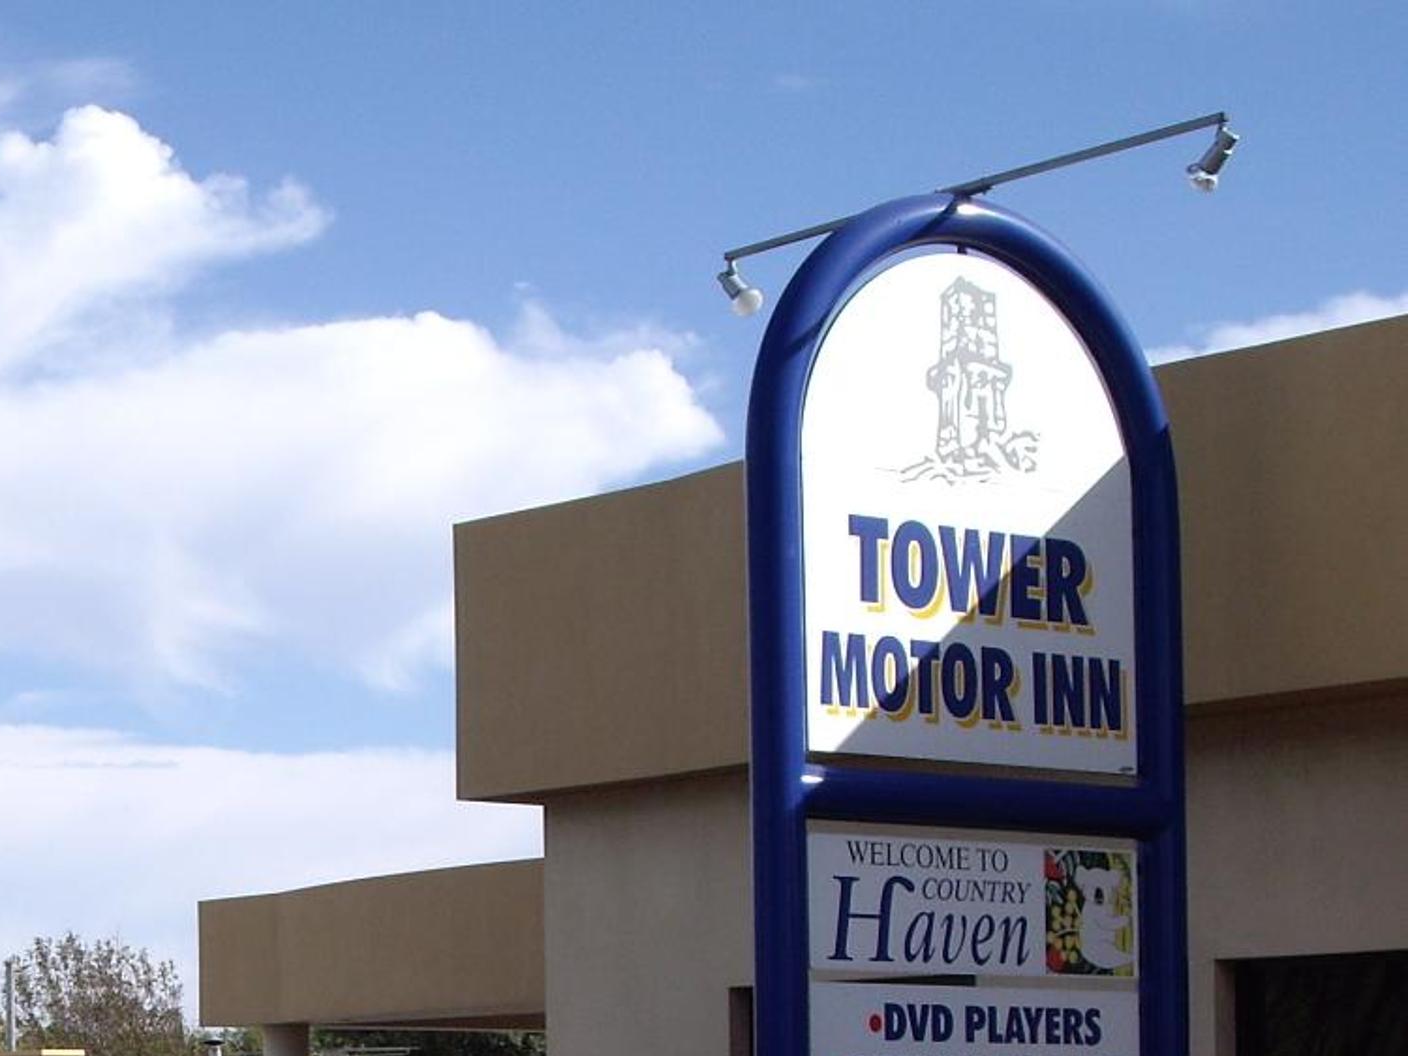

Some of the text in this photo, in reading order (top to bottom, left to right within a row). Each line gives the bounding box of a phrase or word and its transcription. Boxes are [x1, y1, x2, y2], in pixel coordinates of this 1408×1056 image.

[849, 514, 1093, 635] TOWER
[820, 631, 1127, 739] MOTOR INN
[847, 840, 1008, 873] WELCOME TO
[827, 875, 1031, 967] Haven
[922, 877, 1031, 904] COUNTRY
[885, 1003, 1101, 1046] DVD PLAYERS
